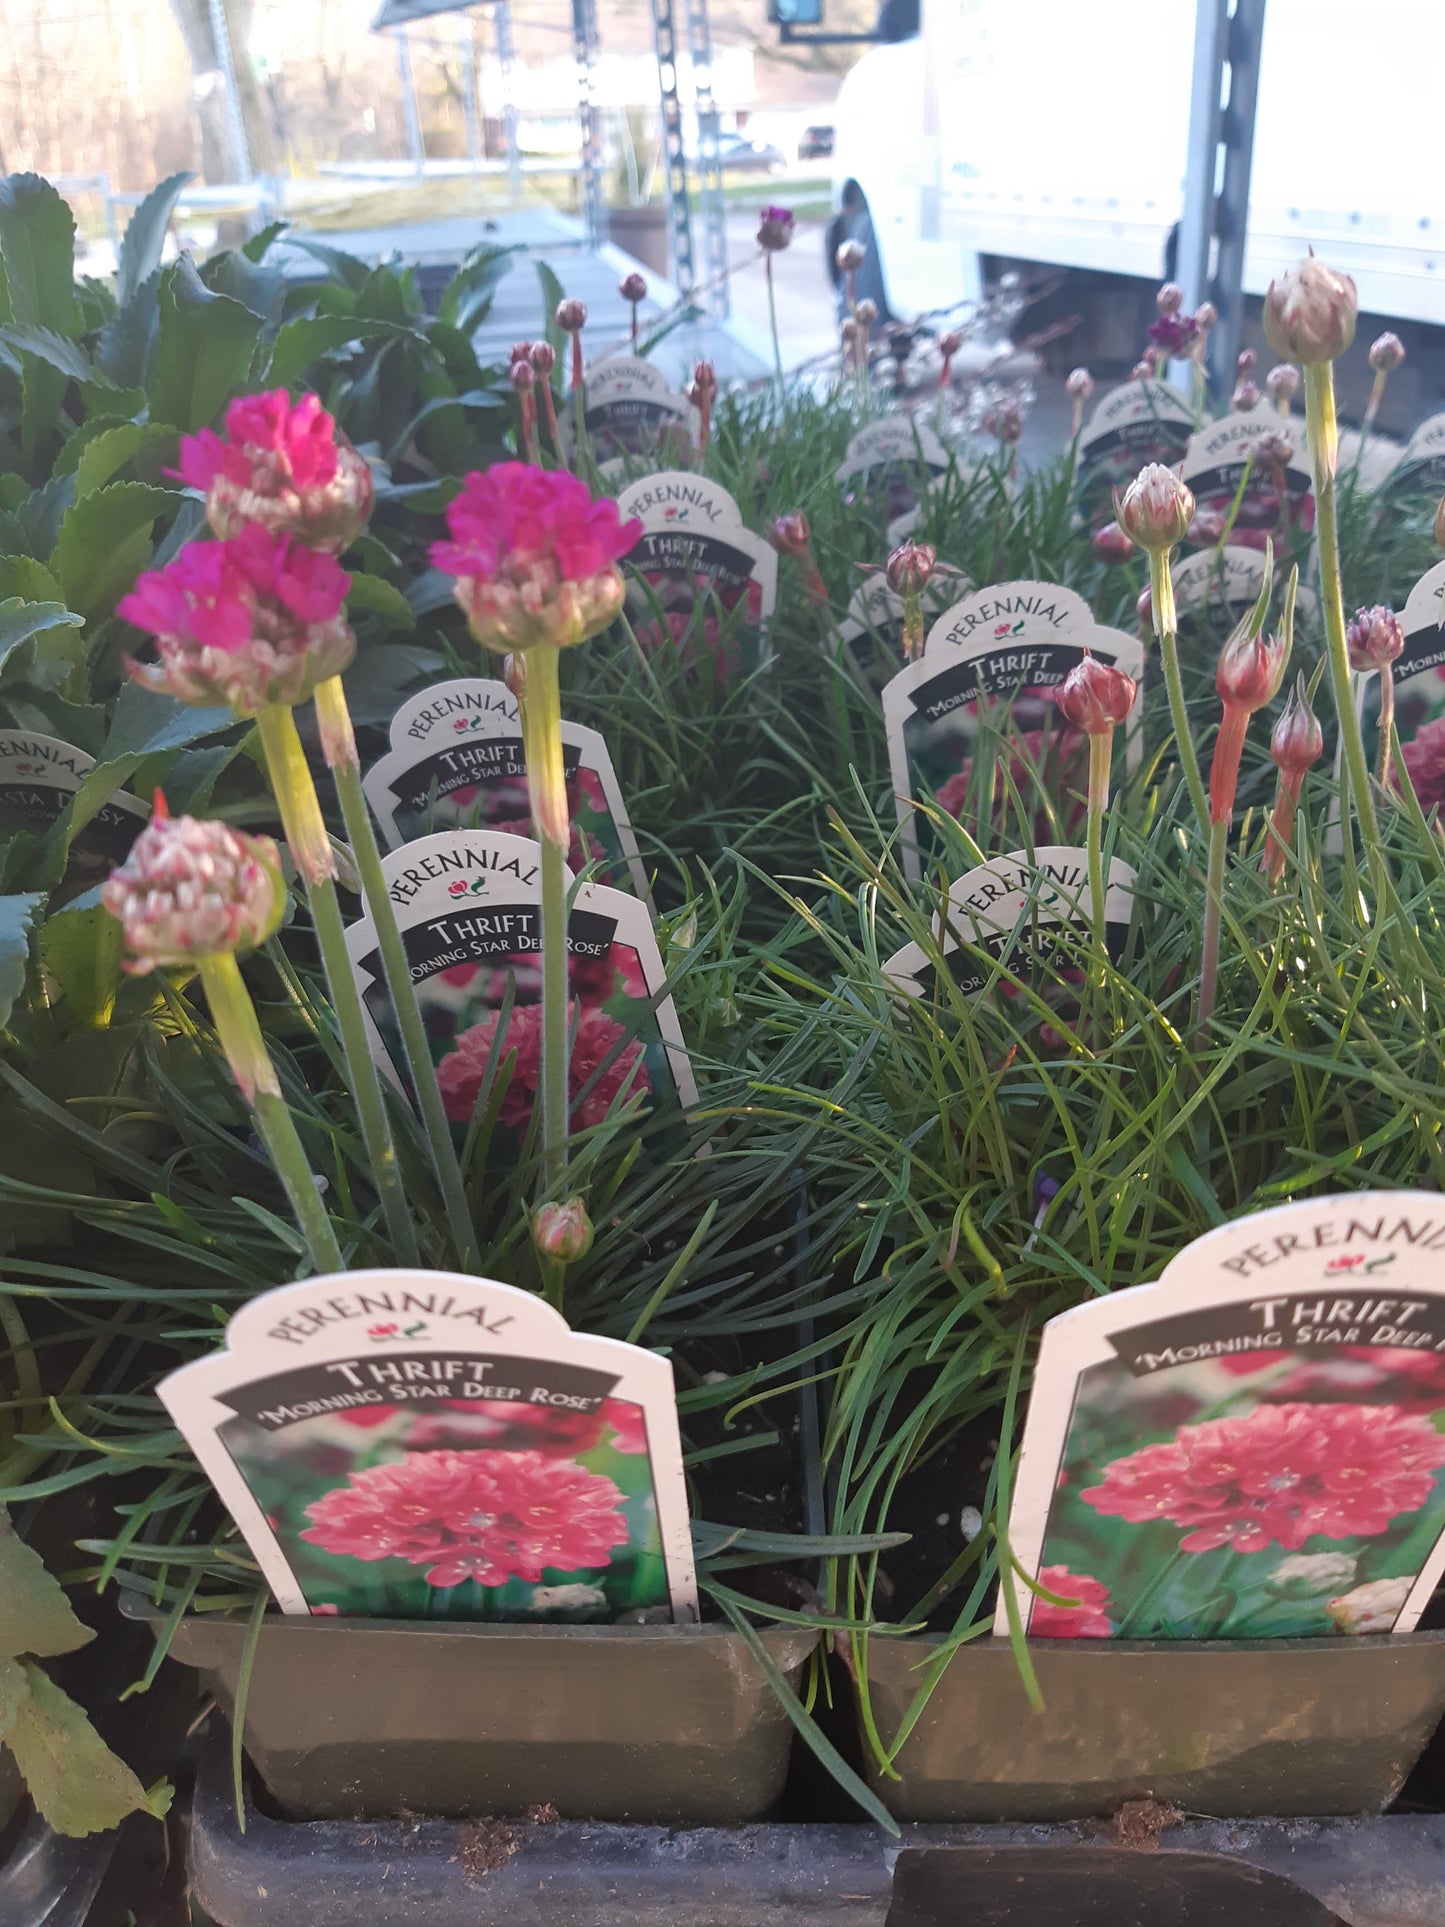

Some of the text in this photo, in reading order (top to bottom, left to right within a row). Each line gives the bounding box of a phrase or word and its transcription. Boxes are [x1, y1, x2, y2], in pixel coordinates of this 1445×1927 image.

[628, 484, 723, 523] PERENNIAL
[945, 596, 1070, 646] PERENNIAL
[968, 652, 1053, 680] THRIFT
[407, 693, 520, 740] PERENNIAL
[0, 740, 92, 780] ENNIAL
[439, 745, 519, 772] THRIFT
[471, 766, 502, 781] STAR
[389, 848, 540, 906] PERENNIAL
[427, 914, 534, 945] THRIFT
[410, 948, 468, 981] ORNING
[470, 939, 511, 956] STAR
[518, 935, 545, 950] DEE
[267, 1290, 518, 1345] PERENNIAL
[1248, 1298, 1428, 1330] THRIFT
[1295, 1324, 1361, 1345] STAR
[1368, 1324, 1434, 1347] DEEP
[326, 1359, 494, 1389] THRIFT
[391, 1383, 451, 1400] STAR
[462, 1381, 521, 1402] DEEP
